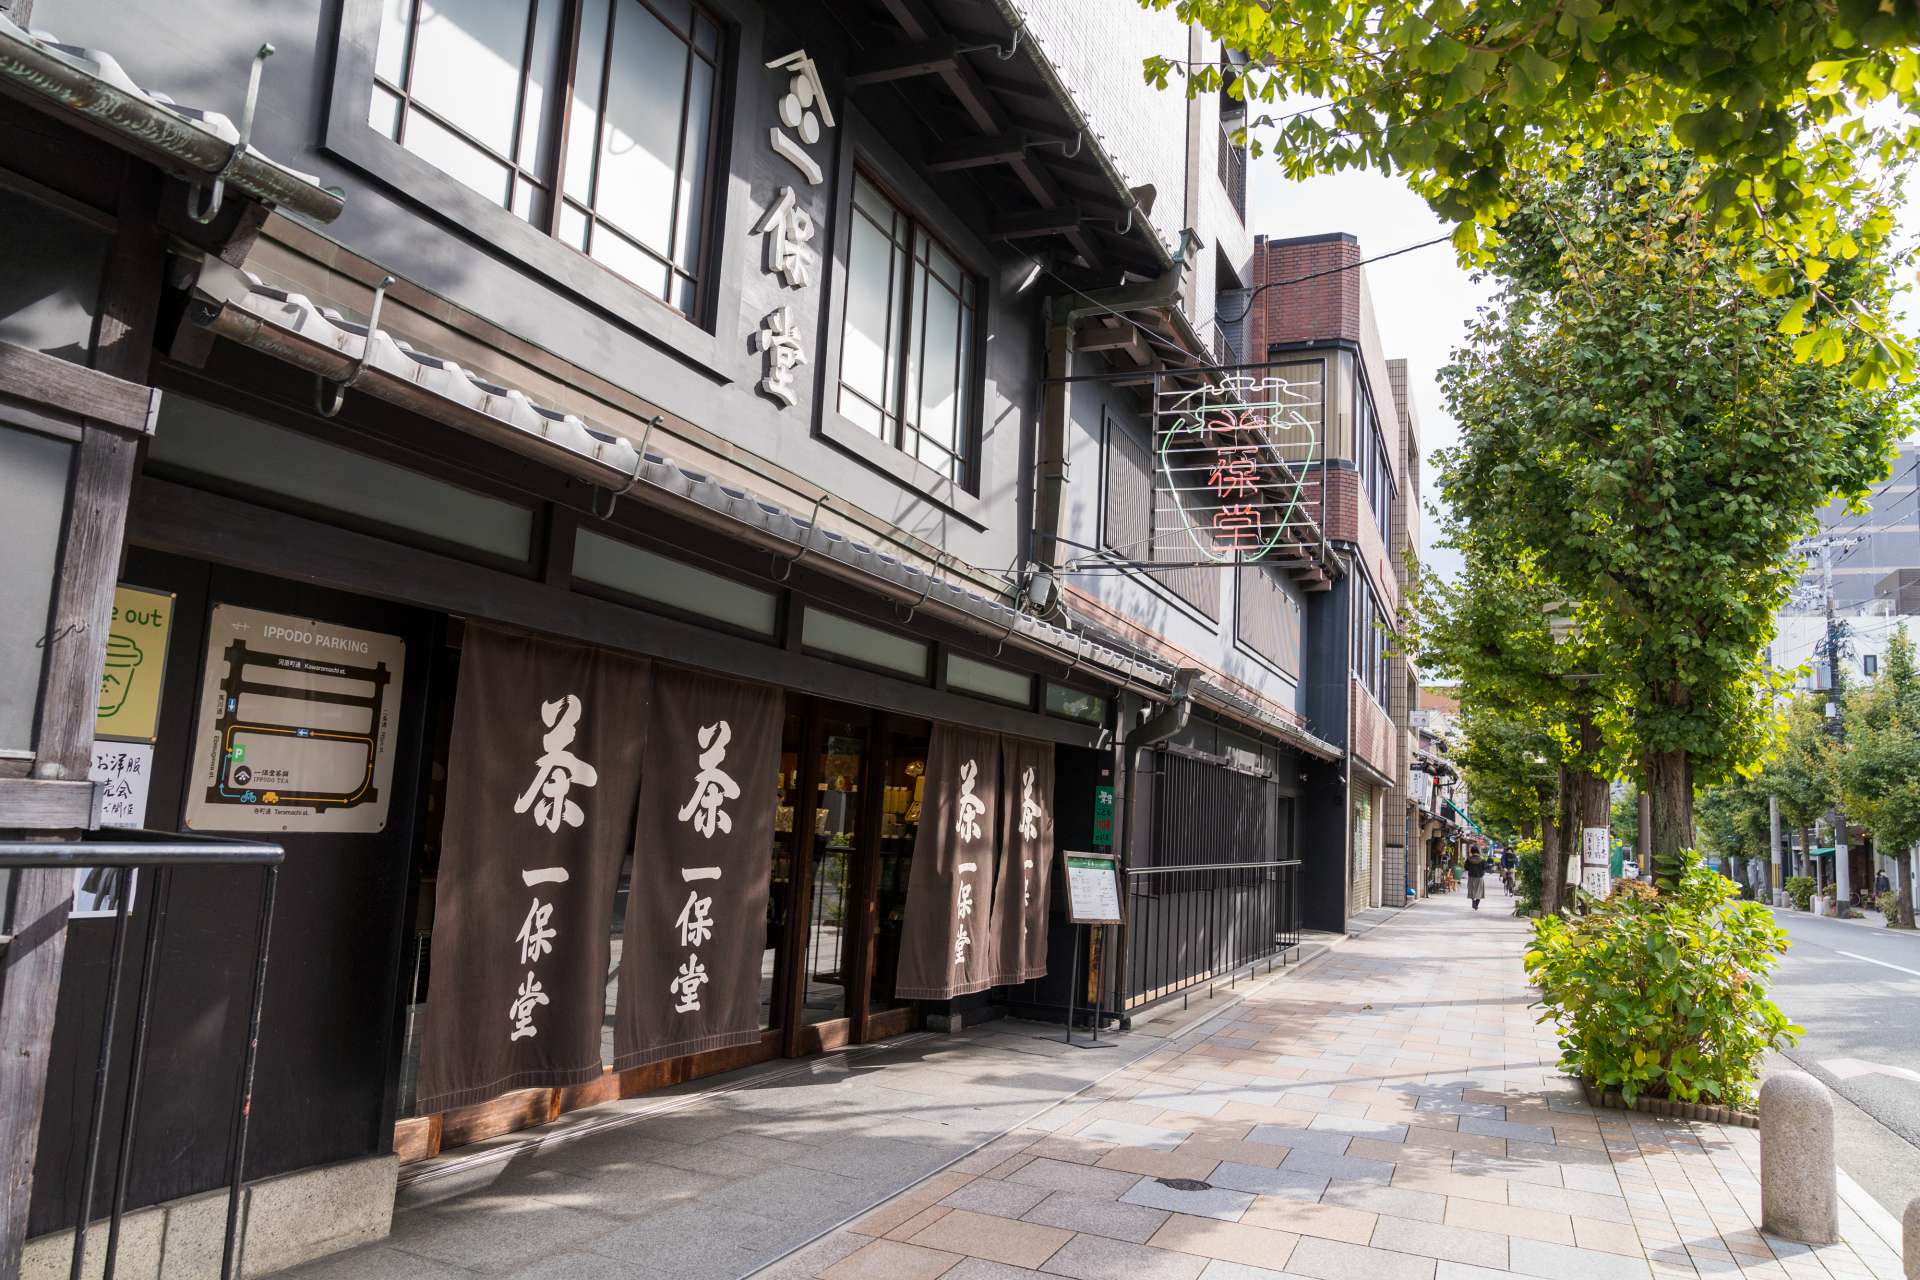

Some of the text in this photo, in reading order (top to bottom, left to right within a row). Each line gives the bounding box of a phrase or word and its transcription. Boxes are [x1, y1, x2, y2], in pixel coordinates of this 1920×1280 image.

[755, 127, 823, 407] 一保堂
[125, 608, 163, 628] out
[263, 624, 369, 655] IPPODO PARKING
[303, 662, 339, 674] Kawaramachi
